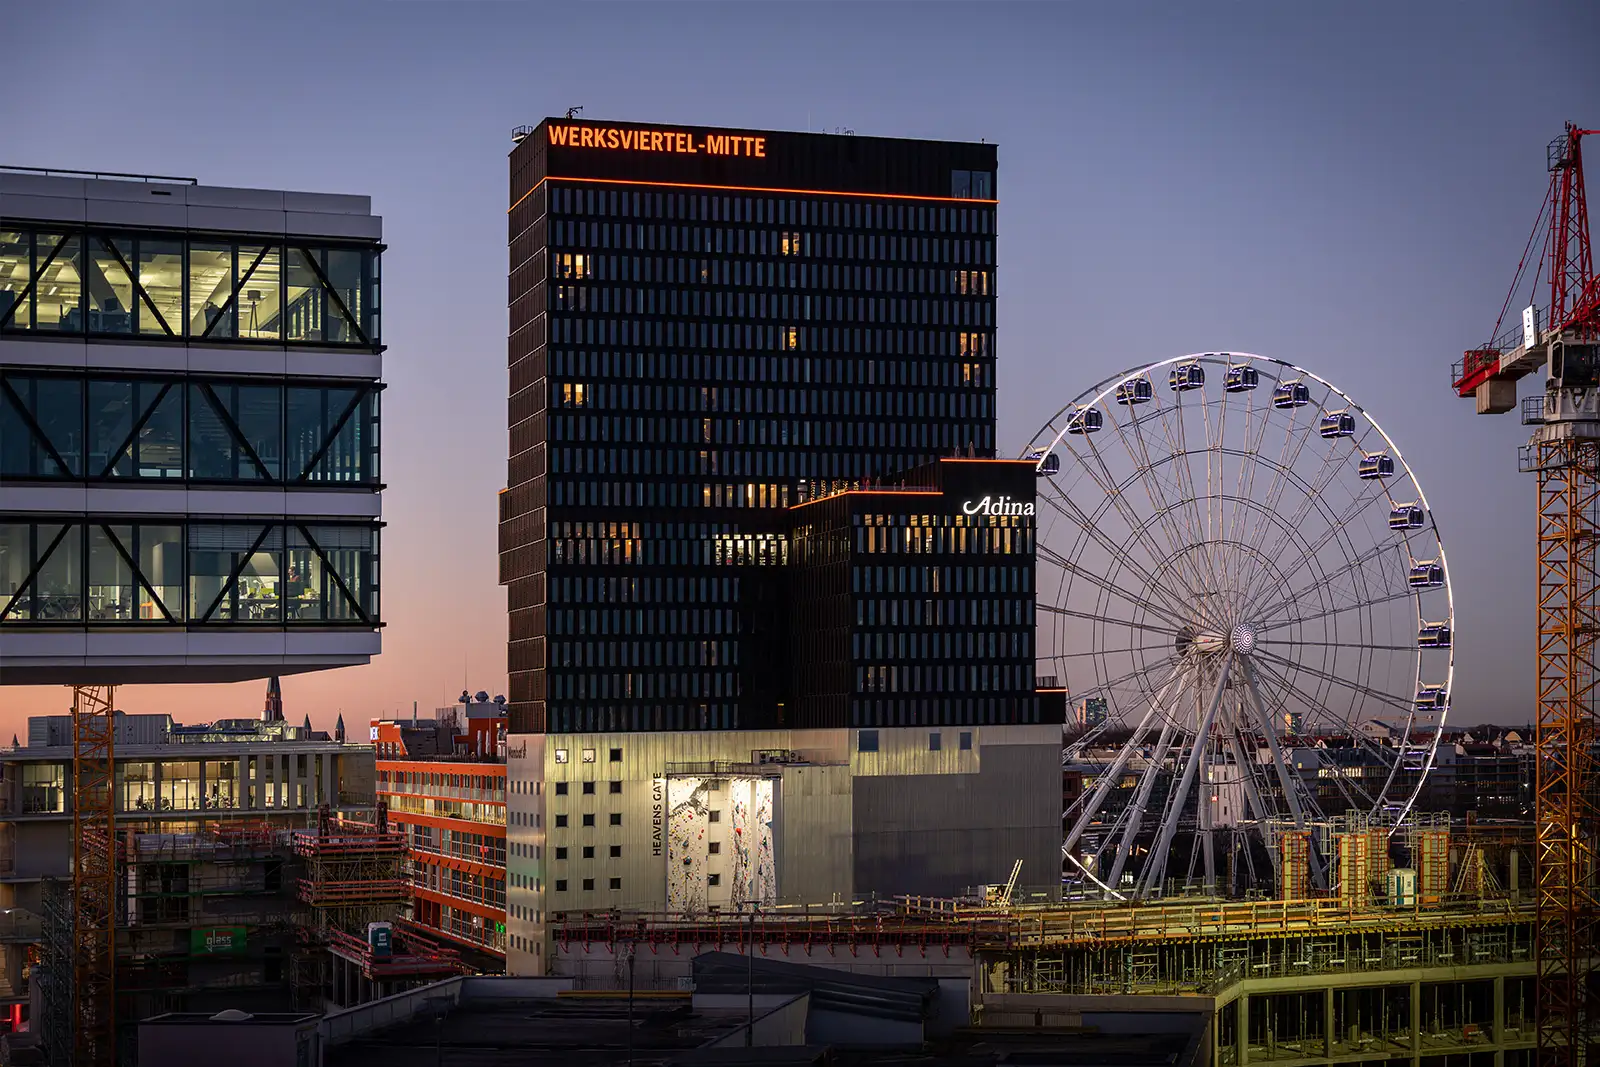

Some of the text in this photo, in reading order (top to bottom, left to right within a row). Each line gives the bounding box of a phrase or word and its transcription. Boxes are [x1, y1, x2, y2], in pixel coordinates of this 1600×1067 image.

[548, 125, 766, 158] WERKSVIERTEL-MITTE
[962, 495, 1035, 516] Adina
[652, 772, 662, 856] HEAVENS GATE
